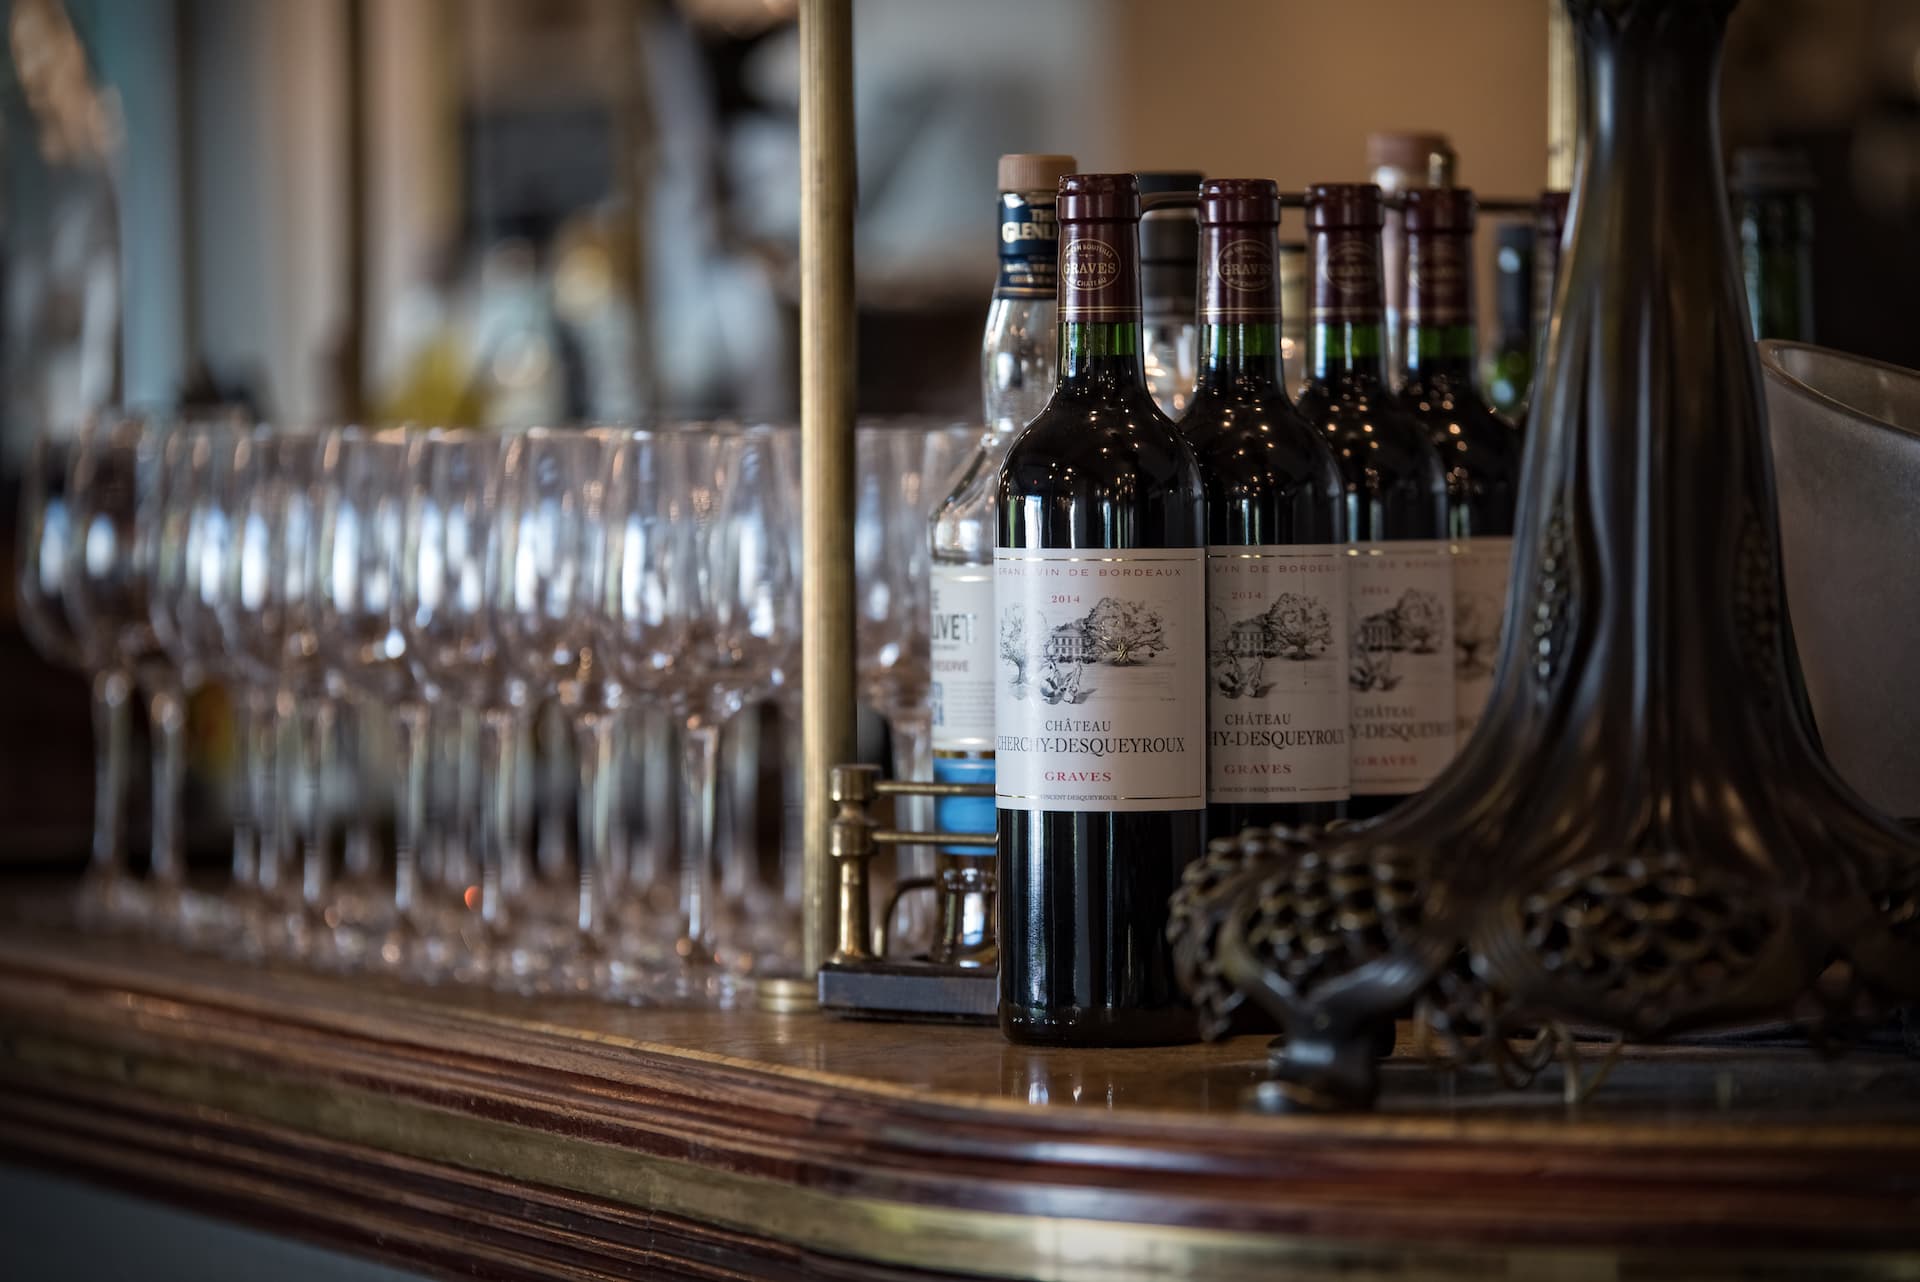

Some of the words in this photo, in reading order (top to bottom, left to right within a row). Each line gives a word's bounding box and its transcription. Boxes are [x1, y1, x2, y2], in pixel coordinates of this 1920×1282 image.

[1063, 262, 1116, 274] GRAVES
[1221, 263, 1272, 275] GRAVES
[1038, 568, 1059, 577] VIN
[1069, 568, 1089, 577] DE
[1099, 568, 1183, 577] BORDEAUX
[1214, 565, 1240, 573] VIN
[1250, 565, 1270, 573] DE
[1279, 564, 1342, 573] BORDE
[1051, 594, 1080, 604] 2014
[1231, 591, 1262, 600] 2014
[1224, 712, 1291, 726] CHÂTEAU
[1045, 718, 1111, 732] CHÂTEAU
[1224, 764, 1292, 775] GRAVES
[1044, 771, 1112, 782] GRAVES
